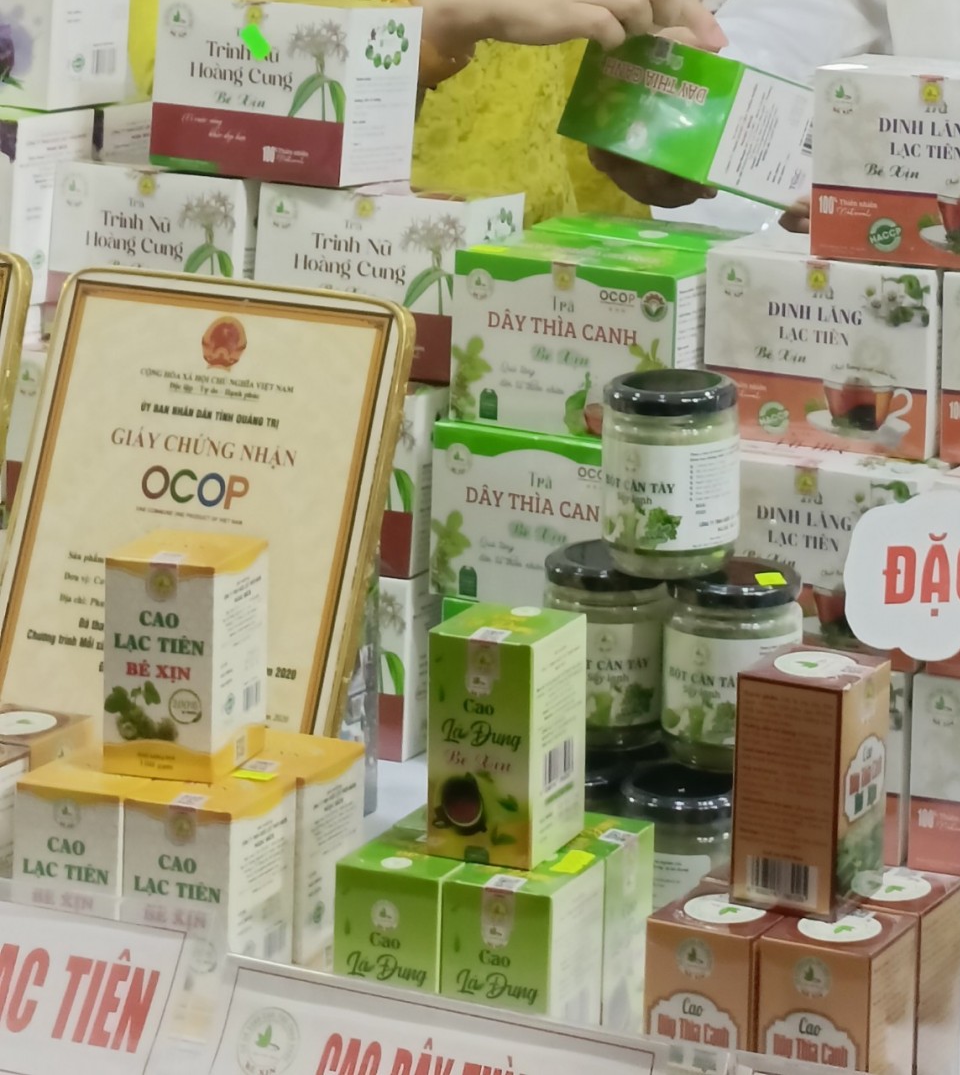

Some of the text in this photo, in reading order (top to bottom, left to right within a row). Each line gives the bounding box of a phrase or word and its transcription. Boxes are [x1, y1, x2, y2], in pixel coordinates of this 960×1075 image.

[204, 39, 254, 62] Trinh
[189, 61, 294, 95] Hoàng Cung
[889, 141, 922, 160] LẠC
[100, 210, 145, 231] Trinh
[85, 230, 184, 262] Hoàng Cung
[311, 232, 362, 254] Trinh
[292, 253, 407, 286] Hoàng Cung
[599, 288, 637, 305] OCOP
[487, 307, 639, 347] DÂY THÌA CANH
[778, 325, 809, 345] LẠC
[164, 433, 235, 461] CHỨNG
[239, 441, 298, 470] NHẬN
[141, 463, 250, 511] OCOP
[464, 483, 602, 525] DÂY THÌA CAN
[139, 609, 181, 628] CAO
[113, 632, 206, 657] LẠC TIÊN
[126, 659, 192, 684] BÉ XỊN
[462, 697, 496, 717] Cao
[47, 835, 86, 857] CAO
[22, 857, 110, 887] LẠC TIÊN
[157, 853, 198, 875] CAO
[133, 875, 223, 905] LẠC TIÊN
[368, 930, 402, 951] Cao
[478, 947, 512, 969] Cao
[51, 947, 162, 1055] TIÊN
[681, 996, 704, 1018] Cao
[798, 1016, 822, 1037] Cao
